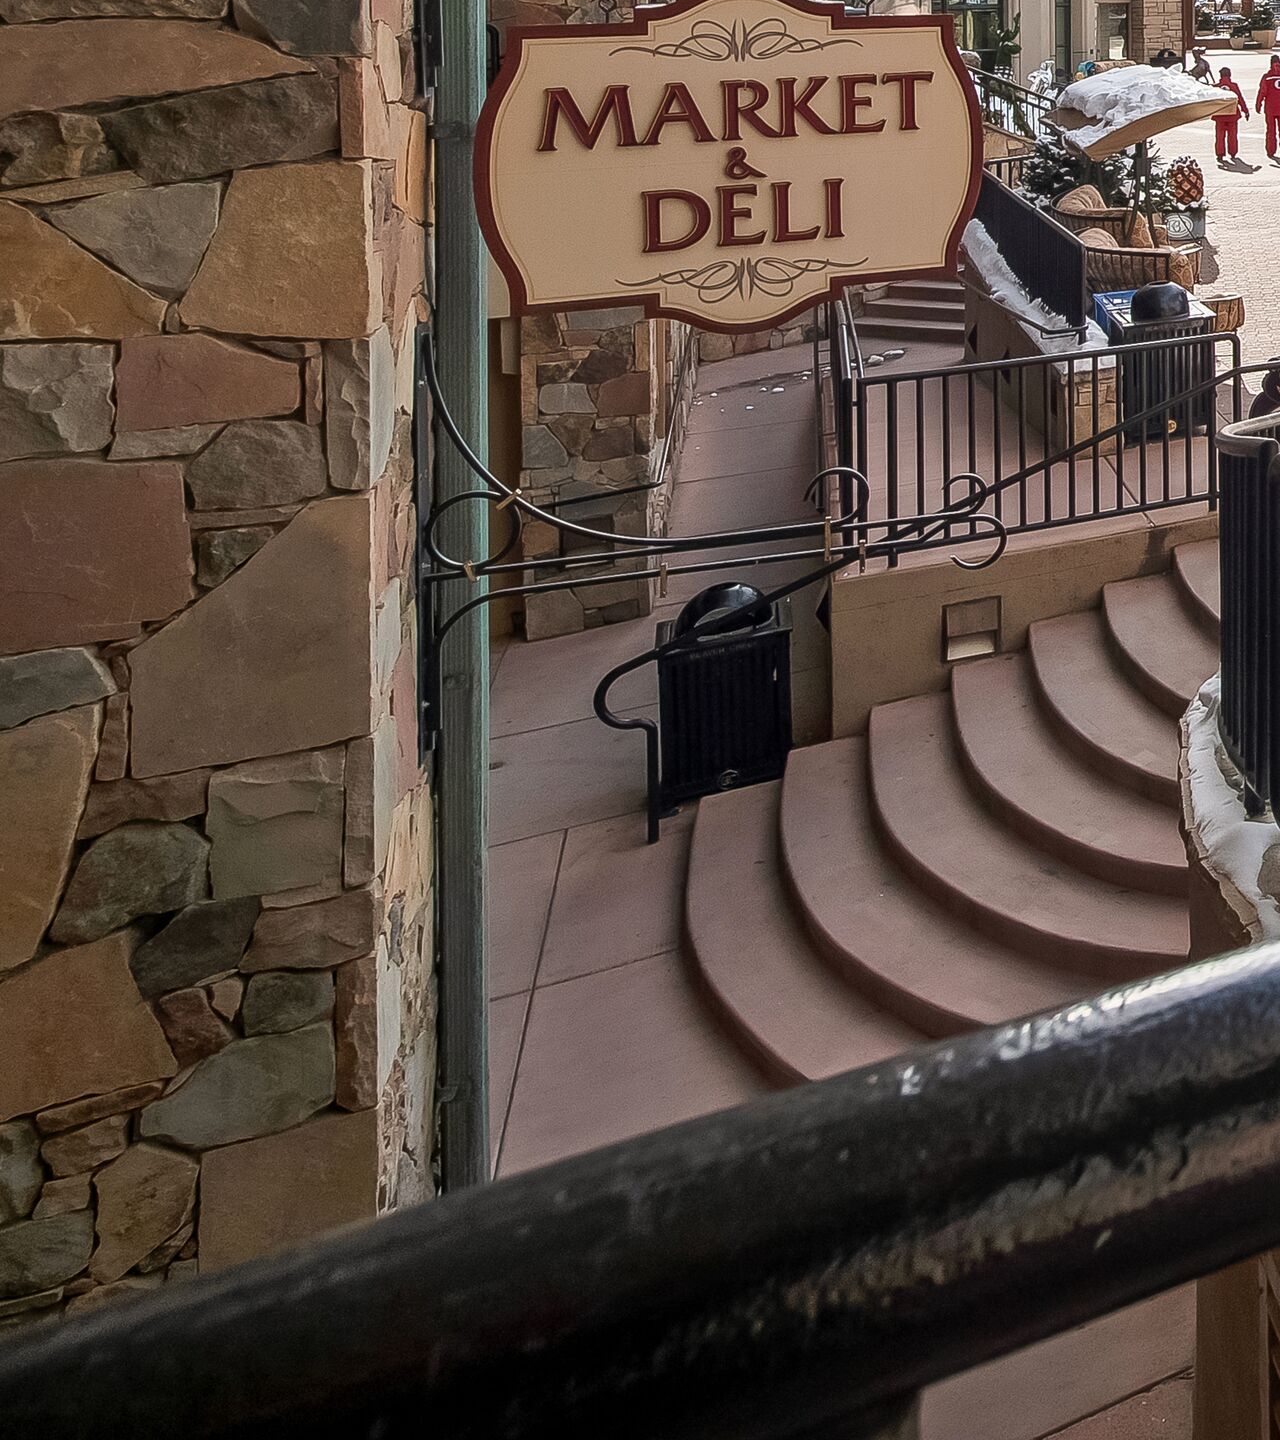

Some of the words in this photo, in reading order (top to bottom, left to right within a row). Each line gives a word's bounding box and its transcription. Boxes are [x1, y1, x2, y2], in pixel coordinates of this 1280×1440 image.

[536, 70, 935, 153] MARKET
[723, 146, 768, 181] &
[641, 177, 846, 254] DELI
